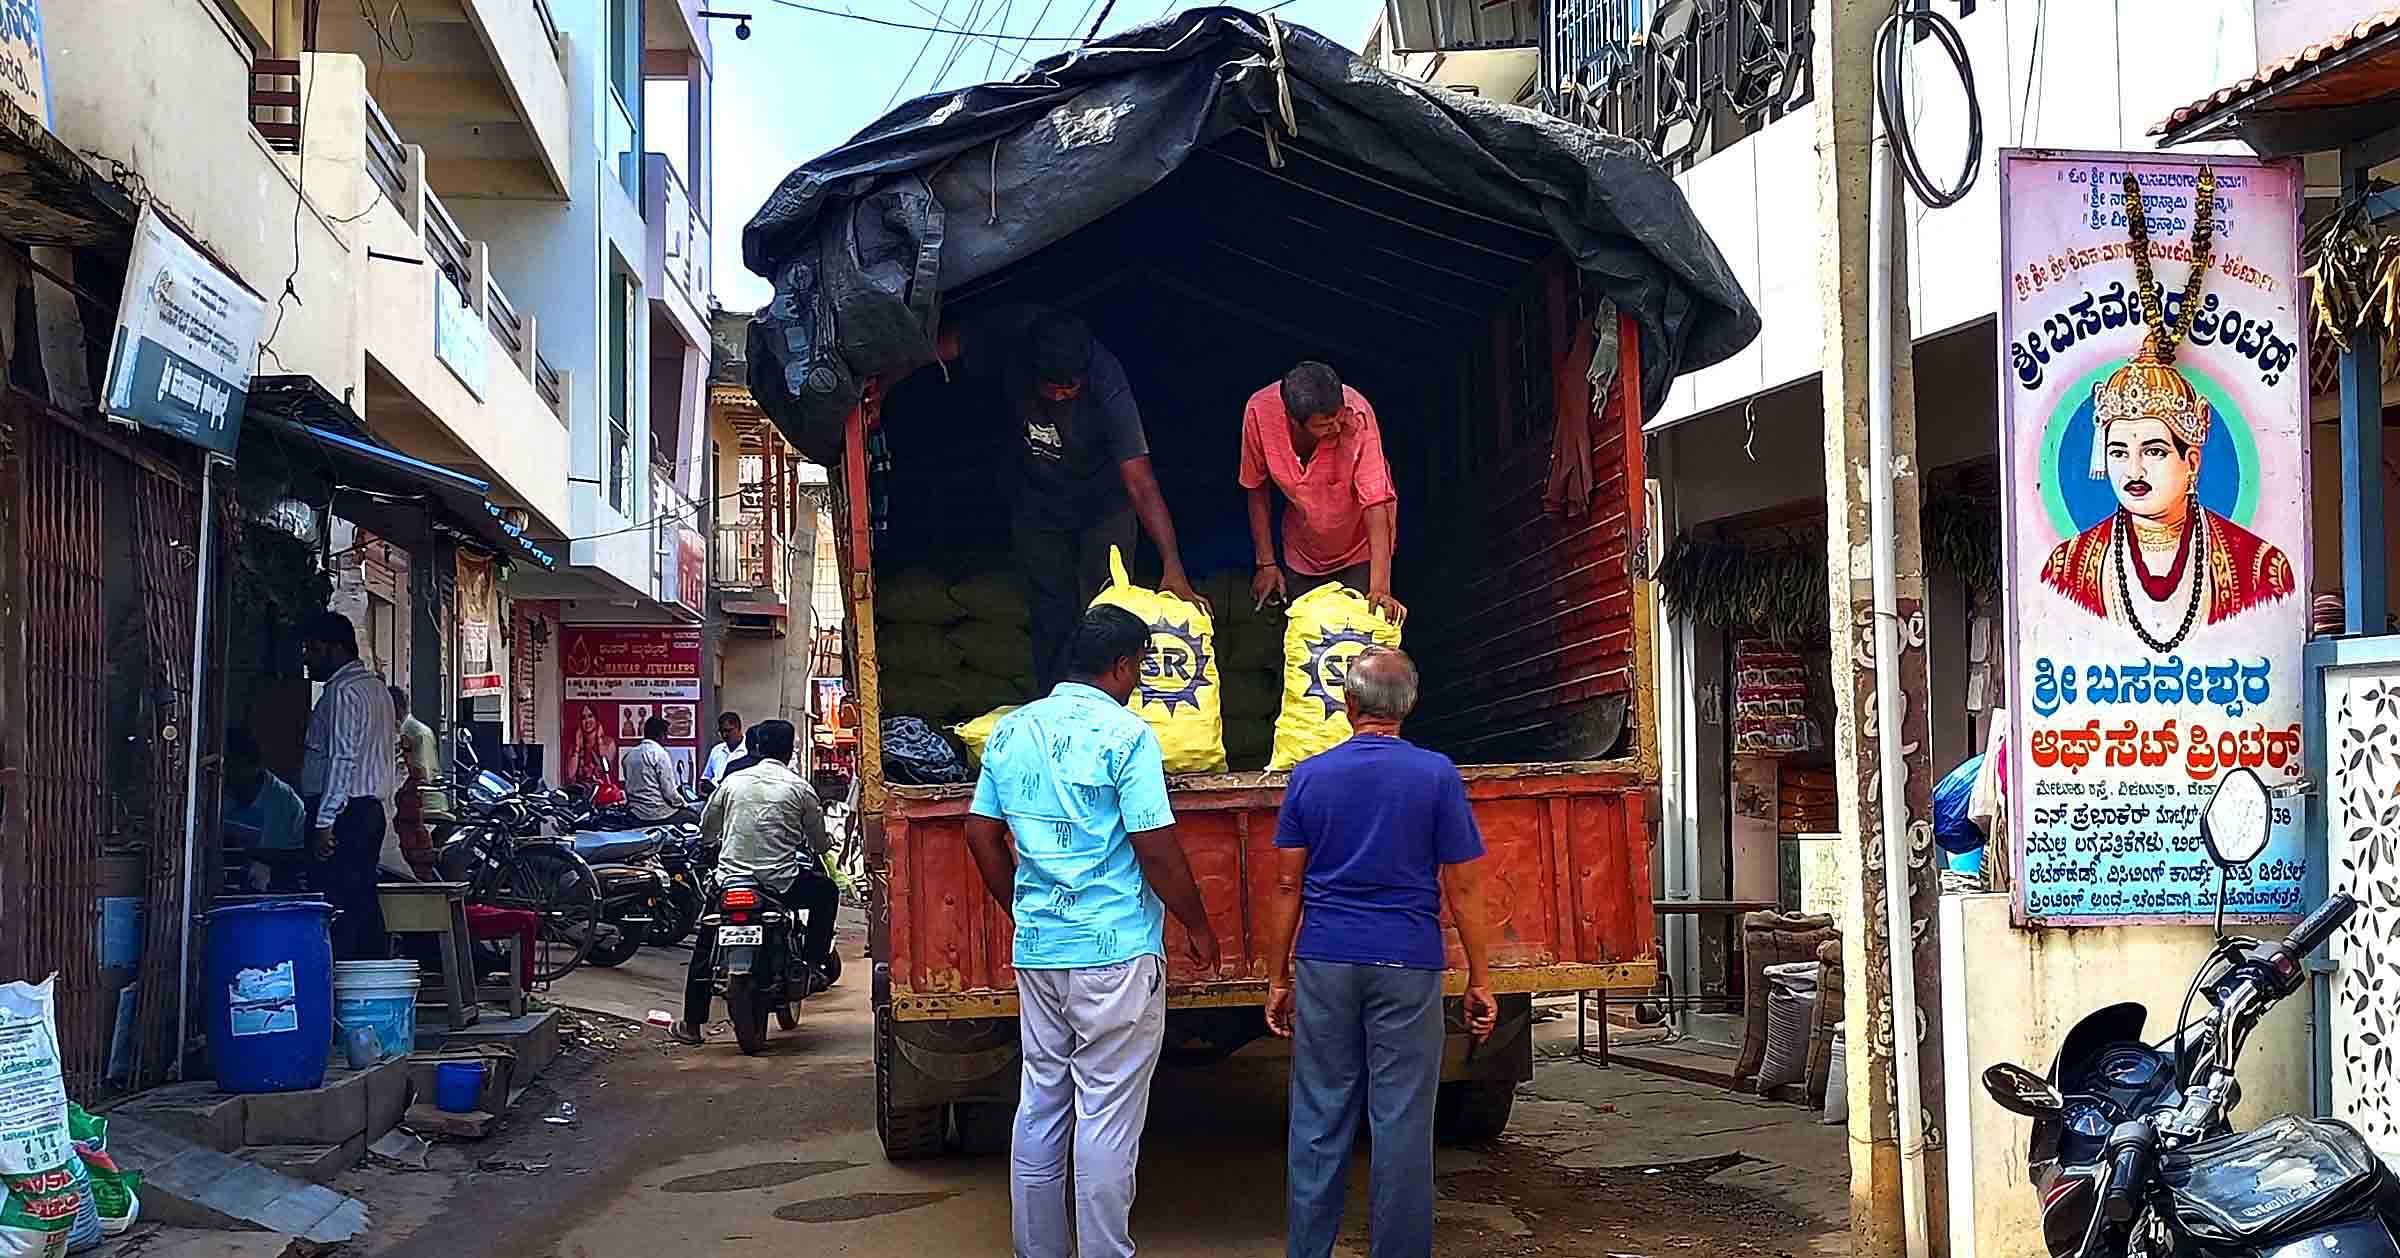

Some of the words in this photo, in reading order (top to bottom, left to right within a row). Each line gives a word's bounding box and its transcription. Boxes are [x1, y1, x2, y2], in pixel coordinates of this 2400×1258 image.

[2090, 166, 2105, 187] ಶ್ರೀ
[2138, 173, 2196, 188] ಬಸವಲಿಂಗಾ
[2090, 187, 2106, 208] ಶ್ರೀ
[2090, 208, 2107, 230] ಶ್ರೀ
[2012, 331, 2050, 391] ಶ್ರೀ
[2032, 657, 2077, 718] ಶ್ರೀ
[2086, 655, 2271, 718] ಬಸವೇಶ್ವರ
[2185, 722, 2300, 780] ಪ್ರಿಂಟರ್ಸ್
[2071, 803, 2150, 831] ಪ್ರಭಾಕರ್
